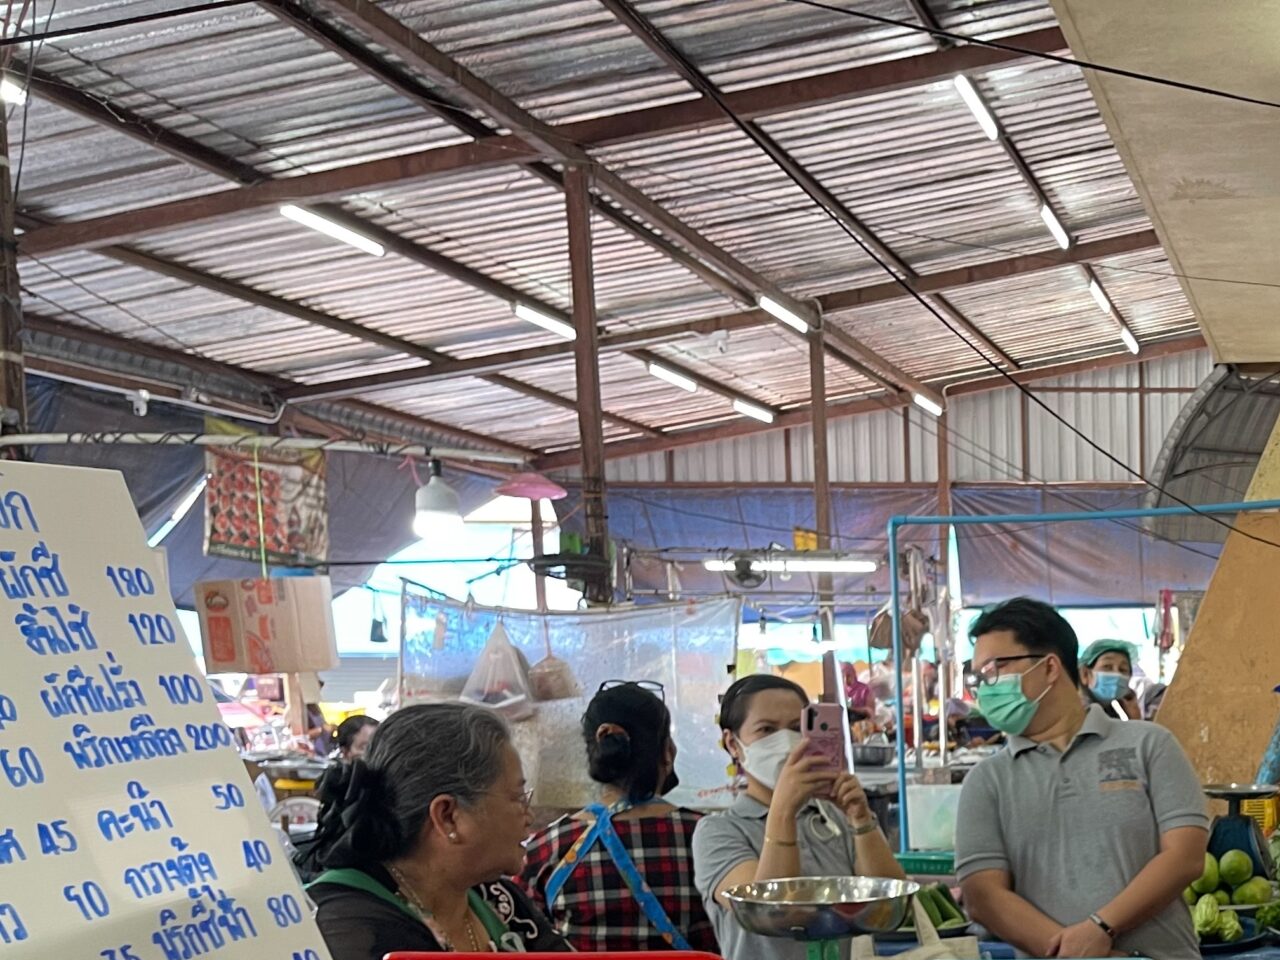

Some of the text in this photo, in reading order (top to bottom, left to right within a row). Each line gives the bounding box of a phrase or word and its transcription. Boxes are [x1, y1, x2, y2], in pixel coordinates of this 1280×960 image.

[106, 566, 154, 597] 180
[128, 613, 176, 645] 120
[159, 674, 203, 704] 100
[185, 723, 231, 750] 200
[0, 747, 44, 787] 60
[97, 781, 245, 841] คะน้า 50
[37, 820, 78, 855] 45
[242, 840, 272, 872] 40
[267, 894, 301, 927] 80
